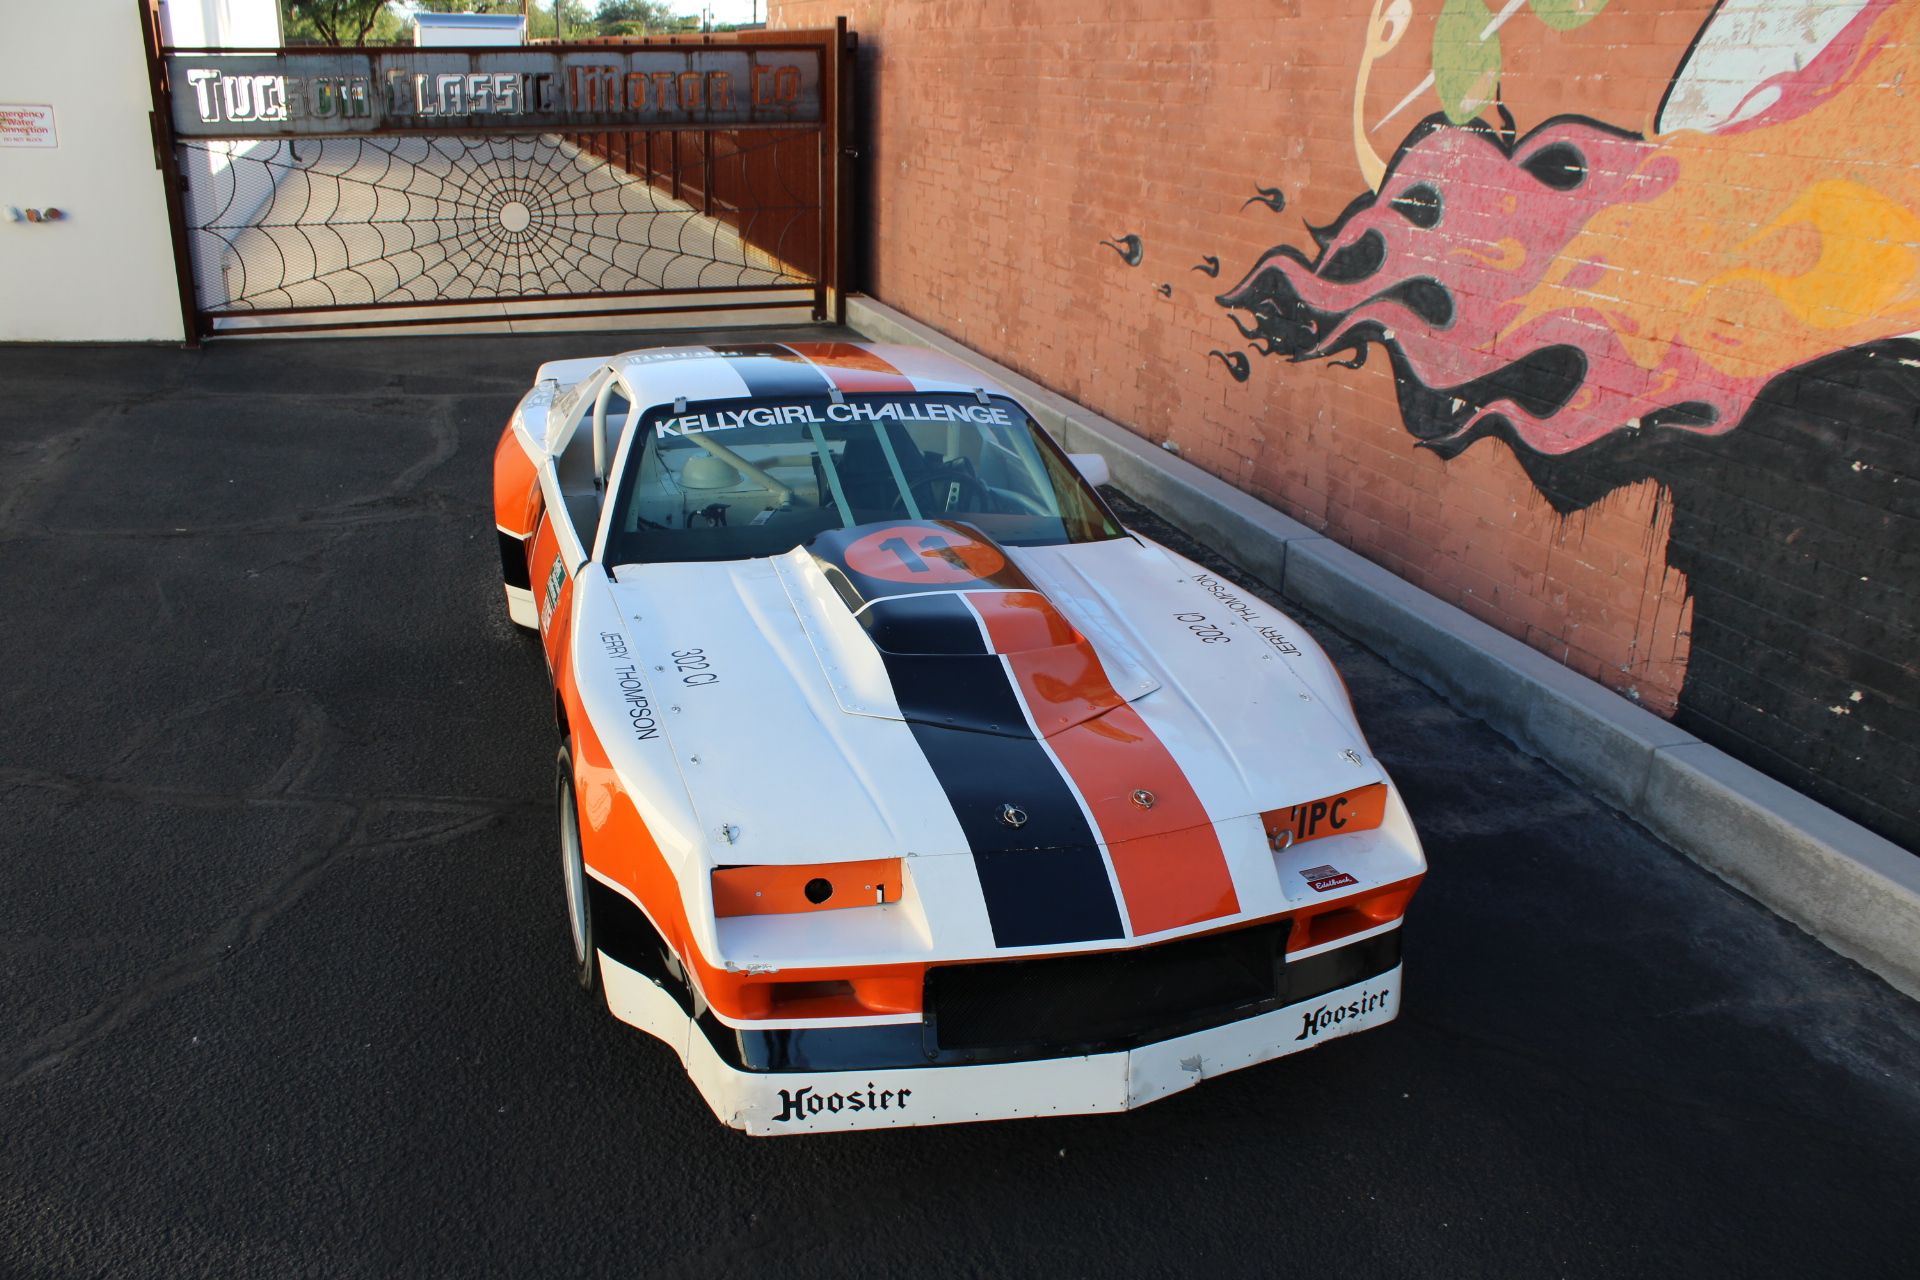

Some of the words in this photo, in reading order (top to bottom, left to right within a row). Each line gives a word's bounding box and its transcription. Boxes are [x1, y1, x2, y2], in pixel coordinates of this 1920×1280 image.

[0, 111, 45, 119] mergency
[654, 405, 826, 439] KELLYGIRL
[826, 403, 1012, 426] CHALLENGE
[878, 535, 971, 573] 11
[1192, 574, 1260, 622] THOMPSON
[600, 631, 631, 660] JERRY
[1188, 624, 1231, 644] 302
[1253, 625, 1302, 657] JERRY
[671, 648, 710, 672] 302
[682, 673, 720, 688] CI
[614, 664, 660, 740] THOMPSON
[1315, 876, 1353, 889] Edelbrock
[1294, 989, 1389, 1041] Hoosier
[771, 1081, 912, 1122] Hoosier
